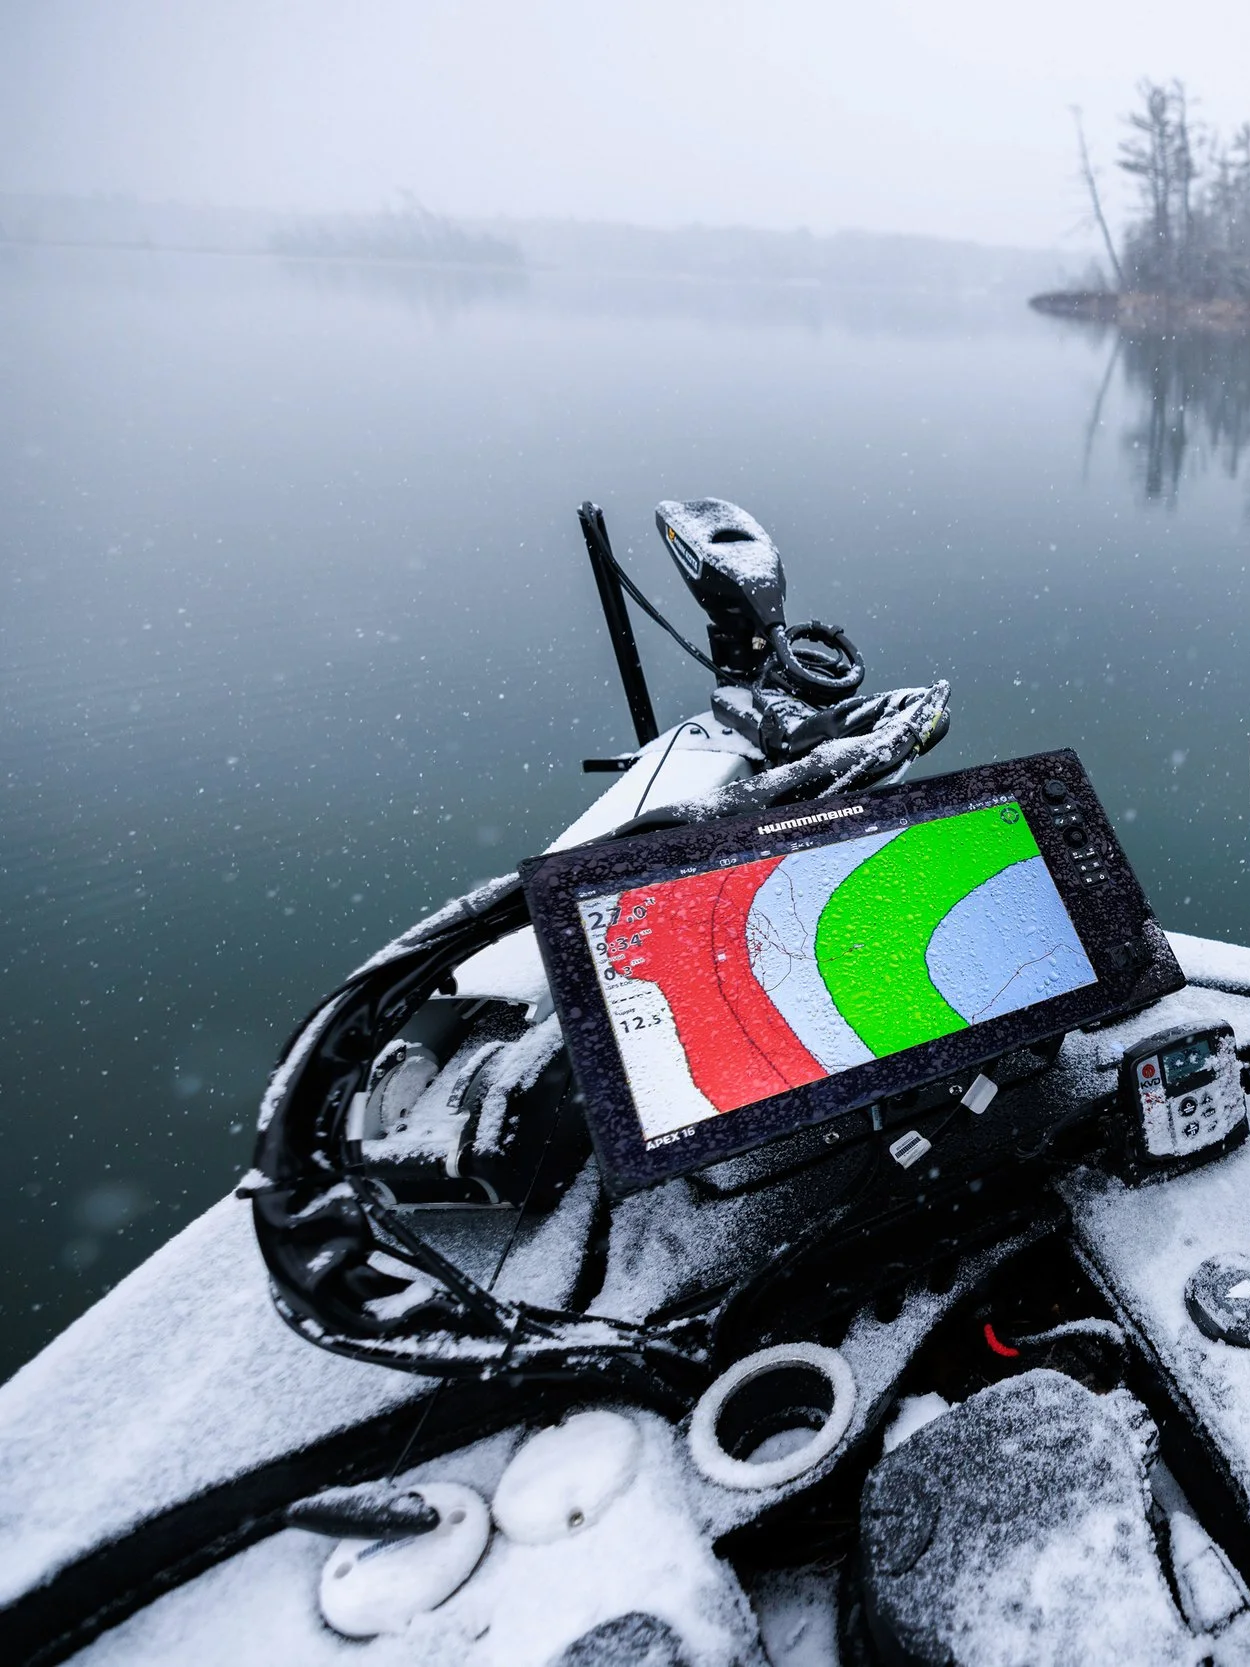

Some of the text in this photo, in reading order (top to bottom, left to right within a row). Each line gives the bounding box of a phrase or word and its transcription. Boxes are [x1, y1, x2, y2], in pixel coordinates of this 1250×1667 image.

[758, 805, 864, 835] HUMMINBIRD
[587, 905, 647, 931] 27.0
[596, 934, 642, 956] 9:34
[603, 966, 632, 981] 0.3
[620, 1014, 661, 1033] 12.5
[1140, 1077, 1161, 1090] KVD
[645, 1126, 696, 1152] APEX 16
